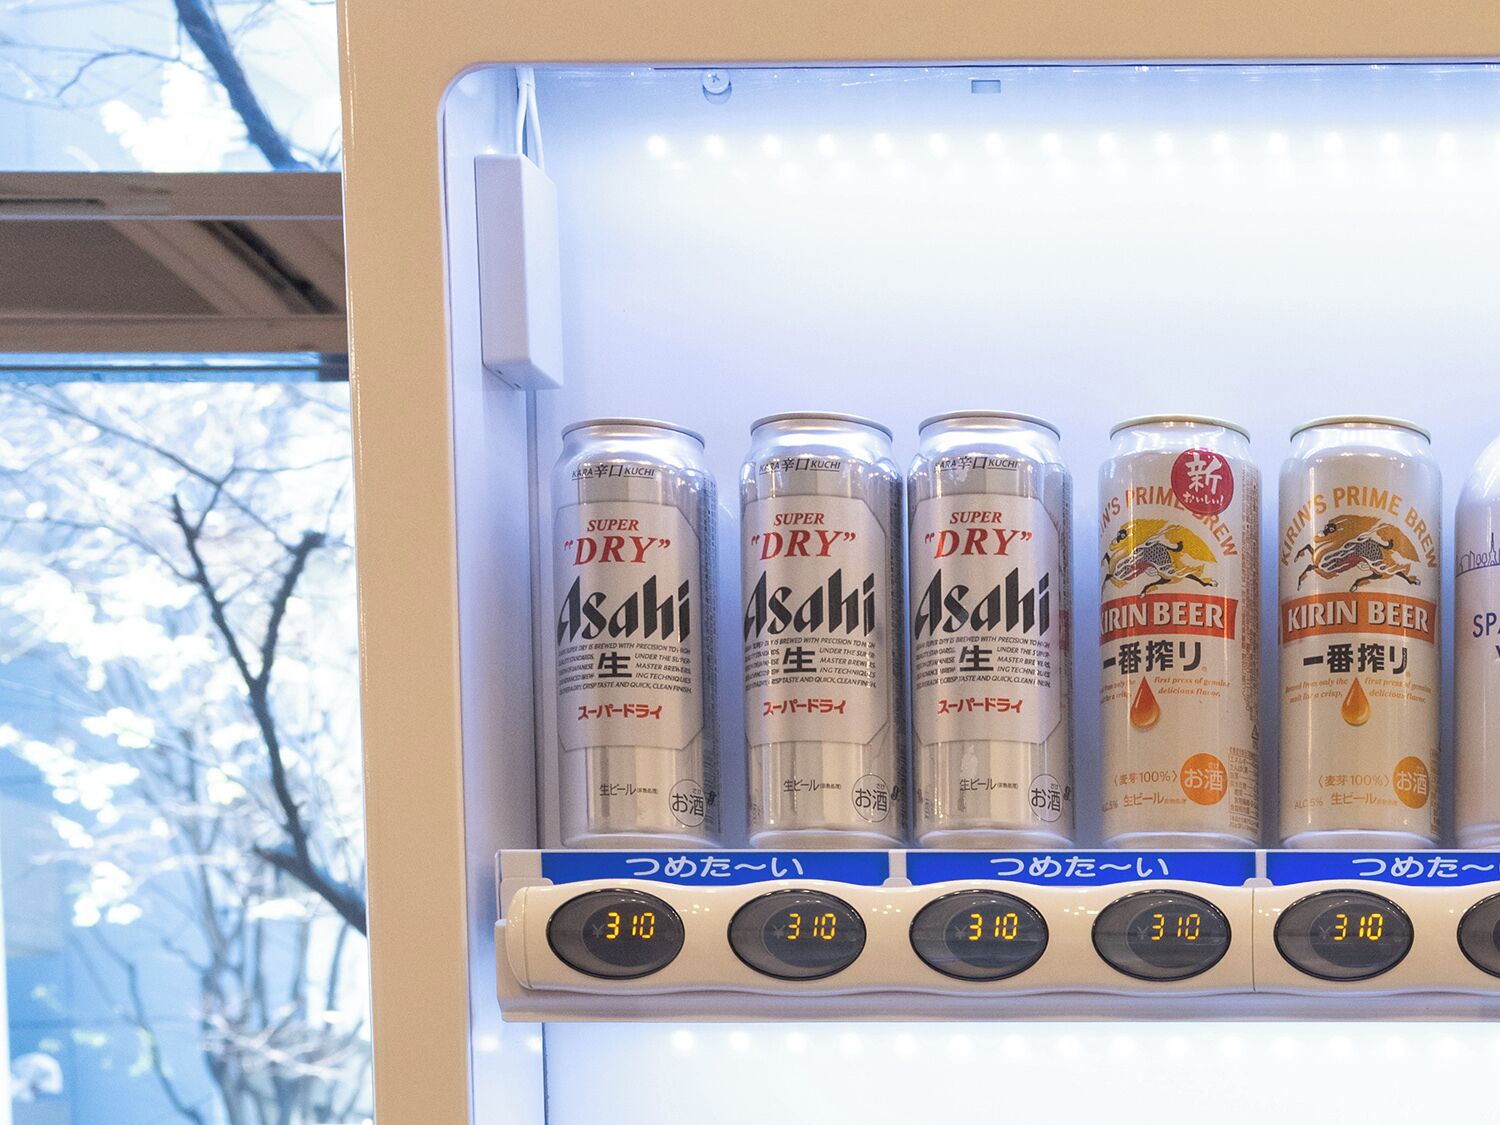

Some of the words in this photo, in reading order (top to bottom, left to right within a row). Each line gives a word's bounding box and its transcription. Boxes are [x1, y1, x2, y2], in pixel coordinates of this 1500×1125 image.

[1185, 451, 1223, 494] 新
[587, 518, 639, 531] SUPER
[774, 512, 825, 526] SUPER
[950, 511, 1002, 524] SUPER
[1333, 485, 1403, 516] PRIME
[1404, 507, 1438, 568] BREW
[557, 574, 691, 646] Asahi
[744, 568, 876, 643] Asahi
[914, 567, 1050, 640] Asahi
[1153, 602, 1225, 630] BEER
[1288, 600, 1358, 632] KIRIN
[1368, 600, 1429, 632] BEER
[597, 651, 632, 678] 生
[782, 646, 817, 673] 生
[958, 645, 994, 672] 生
[1103, 640, 1202, 675] 一番搾り
[1303, 643, 1408, 674] 一番搾り
[578, 703, 662, 720] スーパードライ
[763, 698, 846, 716] スーパードライ
[937, 697, 1023, 714] スーパードライ
[1184, 767, 1224, 792] お酒
[671, 792, 704, 816] お酒
[1031, 787, 1061, 812] お酒
[605, 912, 656, 940] 310
[787, 913, 837, 940] 310
[968, 913, 1019, 941] 310
[1150, 913, 1201, 941] 310
[1333, 914, 1383, 941] 310
